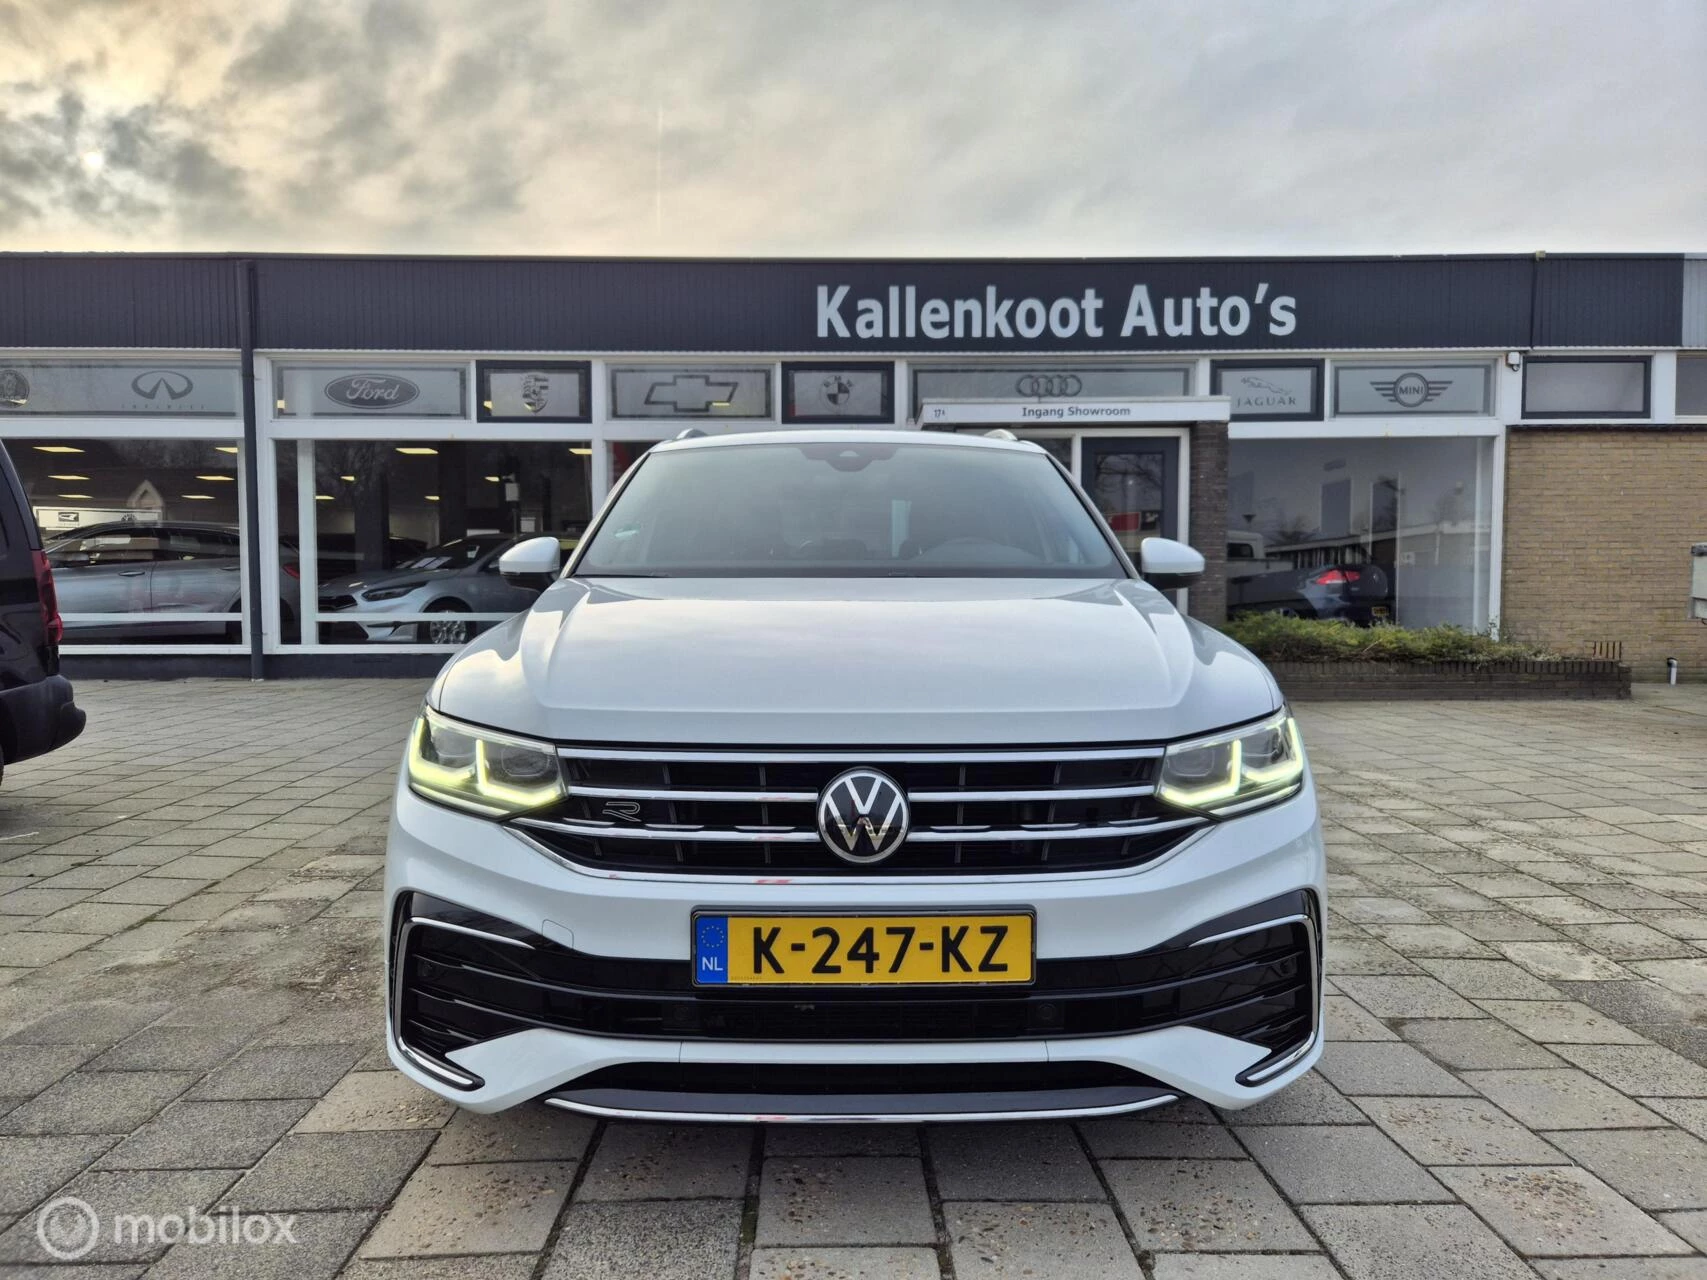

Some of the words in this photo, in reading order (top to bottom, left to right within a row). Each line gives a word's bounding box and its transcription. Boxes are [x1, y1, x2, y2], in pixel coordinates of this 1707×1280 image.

[816, 284, 1103, 339] Kallenkoot
[1120, 283, 1297, 337] Auto's
[346, 378, 400, 400] Ford
[1400, 385, 1424, 395] MINI
[1237, 396, 1296, 408] JAGUAR
[1022, 407, 1064, 418] Ingang
[1067, 406, 1131, 416] Showroom
[753, 925, 1008, 974] K-247-KZ
[702, 956, 724, 971] NL
